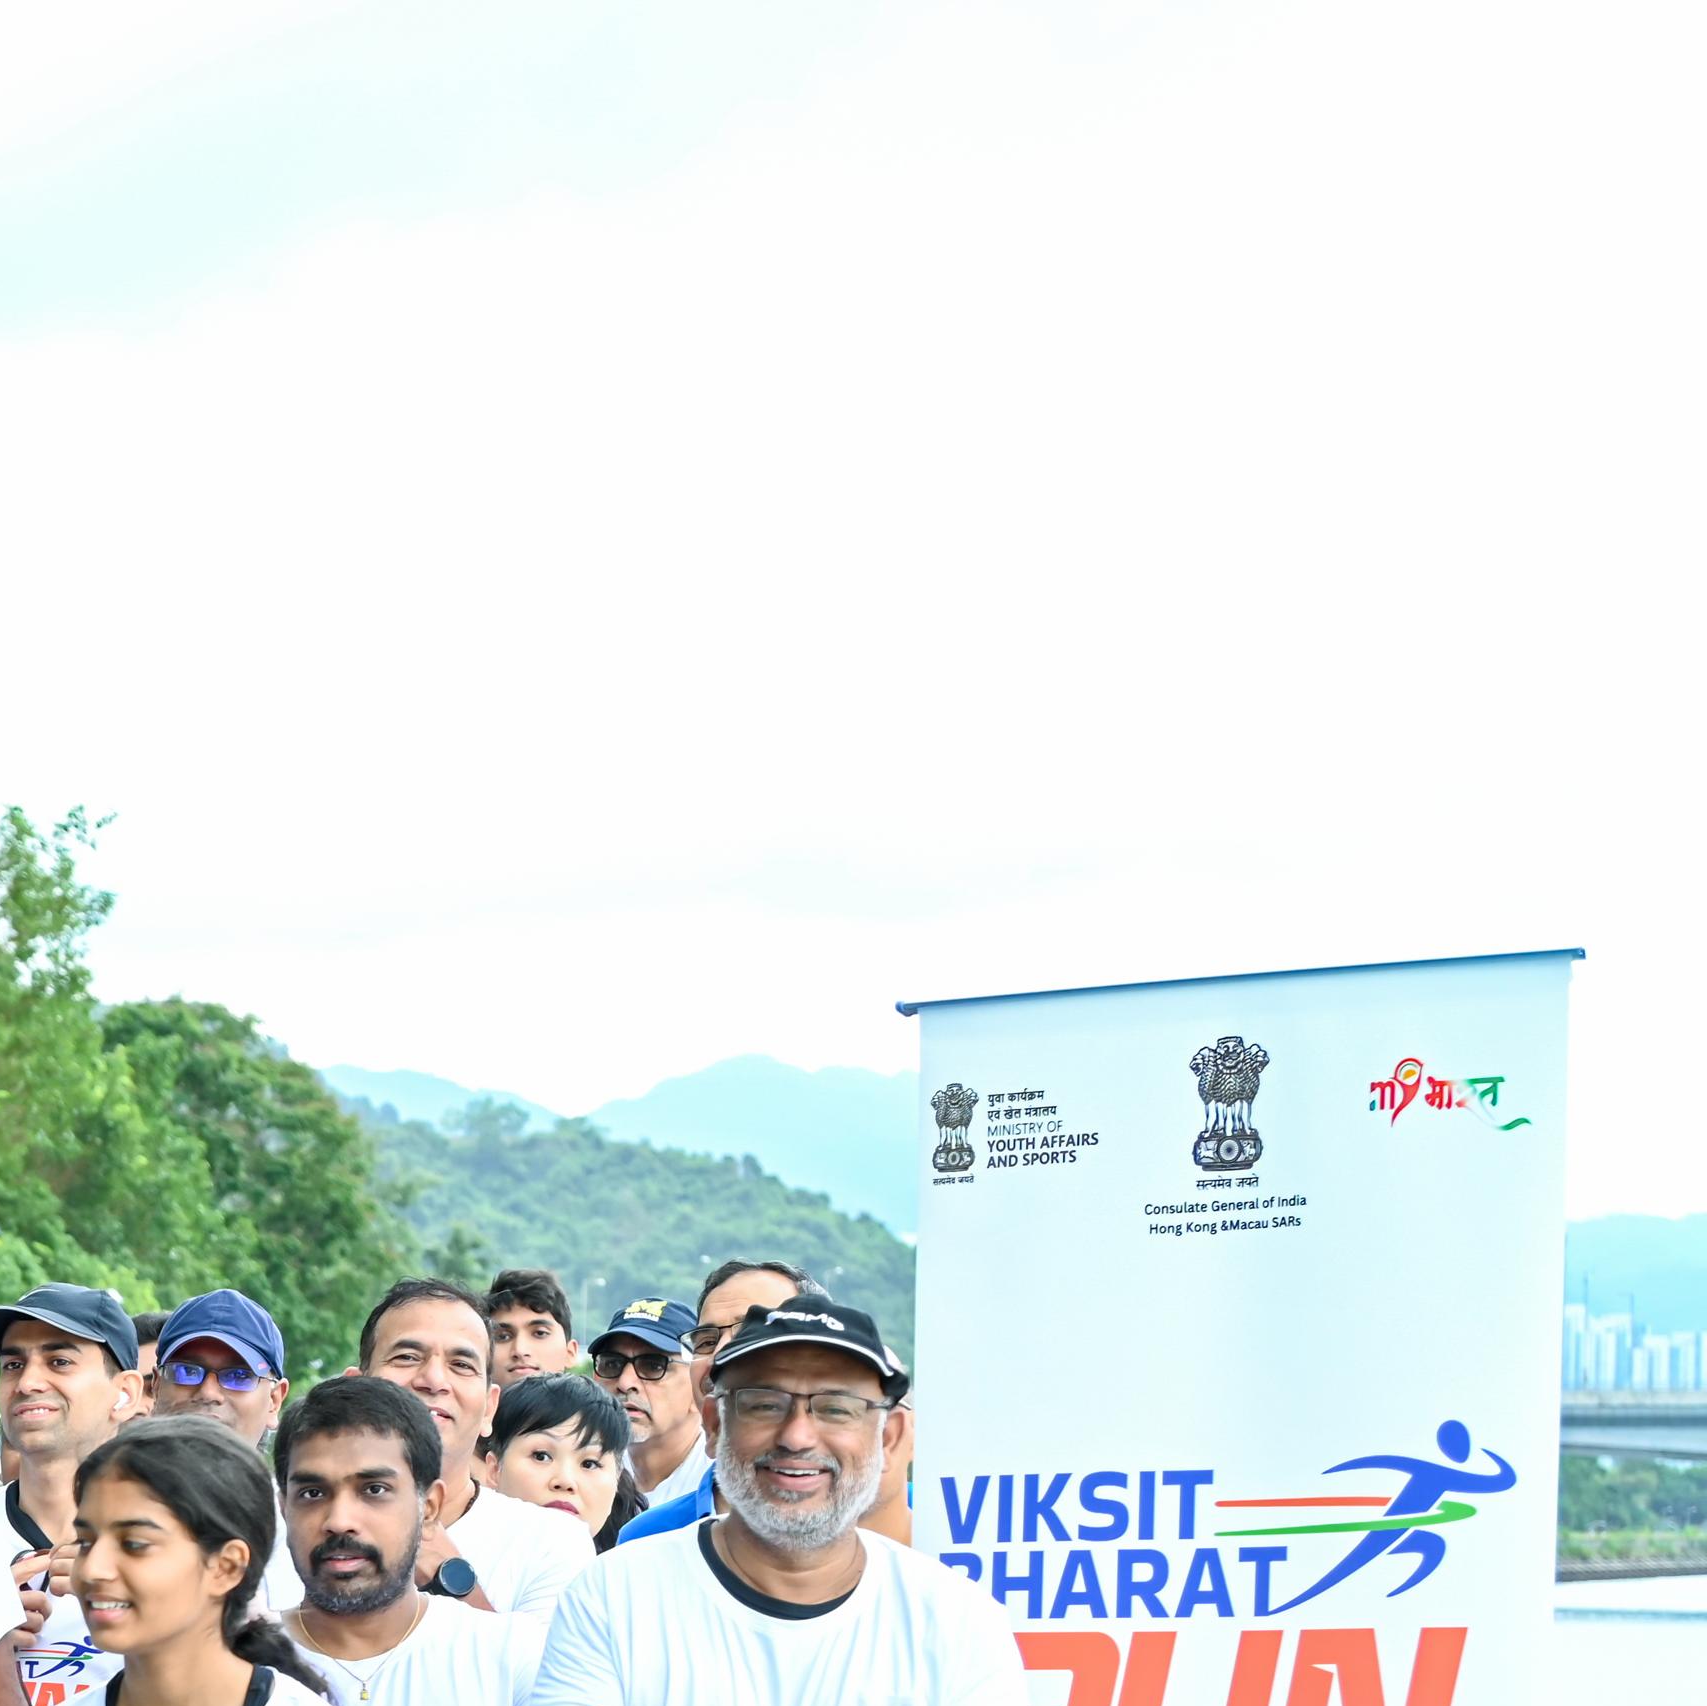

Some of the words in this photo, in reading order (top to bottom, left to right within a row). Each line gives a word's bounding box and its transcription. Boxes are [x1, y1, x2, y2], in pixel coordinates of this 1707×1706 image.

[987, 1122, 1043, 1137] MINISTRY
[1046, 1120, 1063, 1133] OF
[987, 1137, 1036, 1153] YOUTH
[1039, 1132, 1099, 1150] AFFAIRS
[986, 1154, 1018, 1169] AND
[1022, 1150, 1077, 1166] SPORTS
[1144, 1201, 1208, 1215] Consulate
[1211, 1198, 1260, 1213] General
[1262, 1196, 1275, 1209] of
[1277, 1194, 1307, 1207] India
[1149, 1222, 1183, 1236] Hong
[1186, 1221, 1218, 1235] Kong
[1220, 1218, 1269, 1232] &Macau
[1271, 1216, 1302, 1228] SARs
[940, 1469, 1214, 1545] VIKSIT
